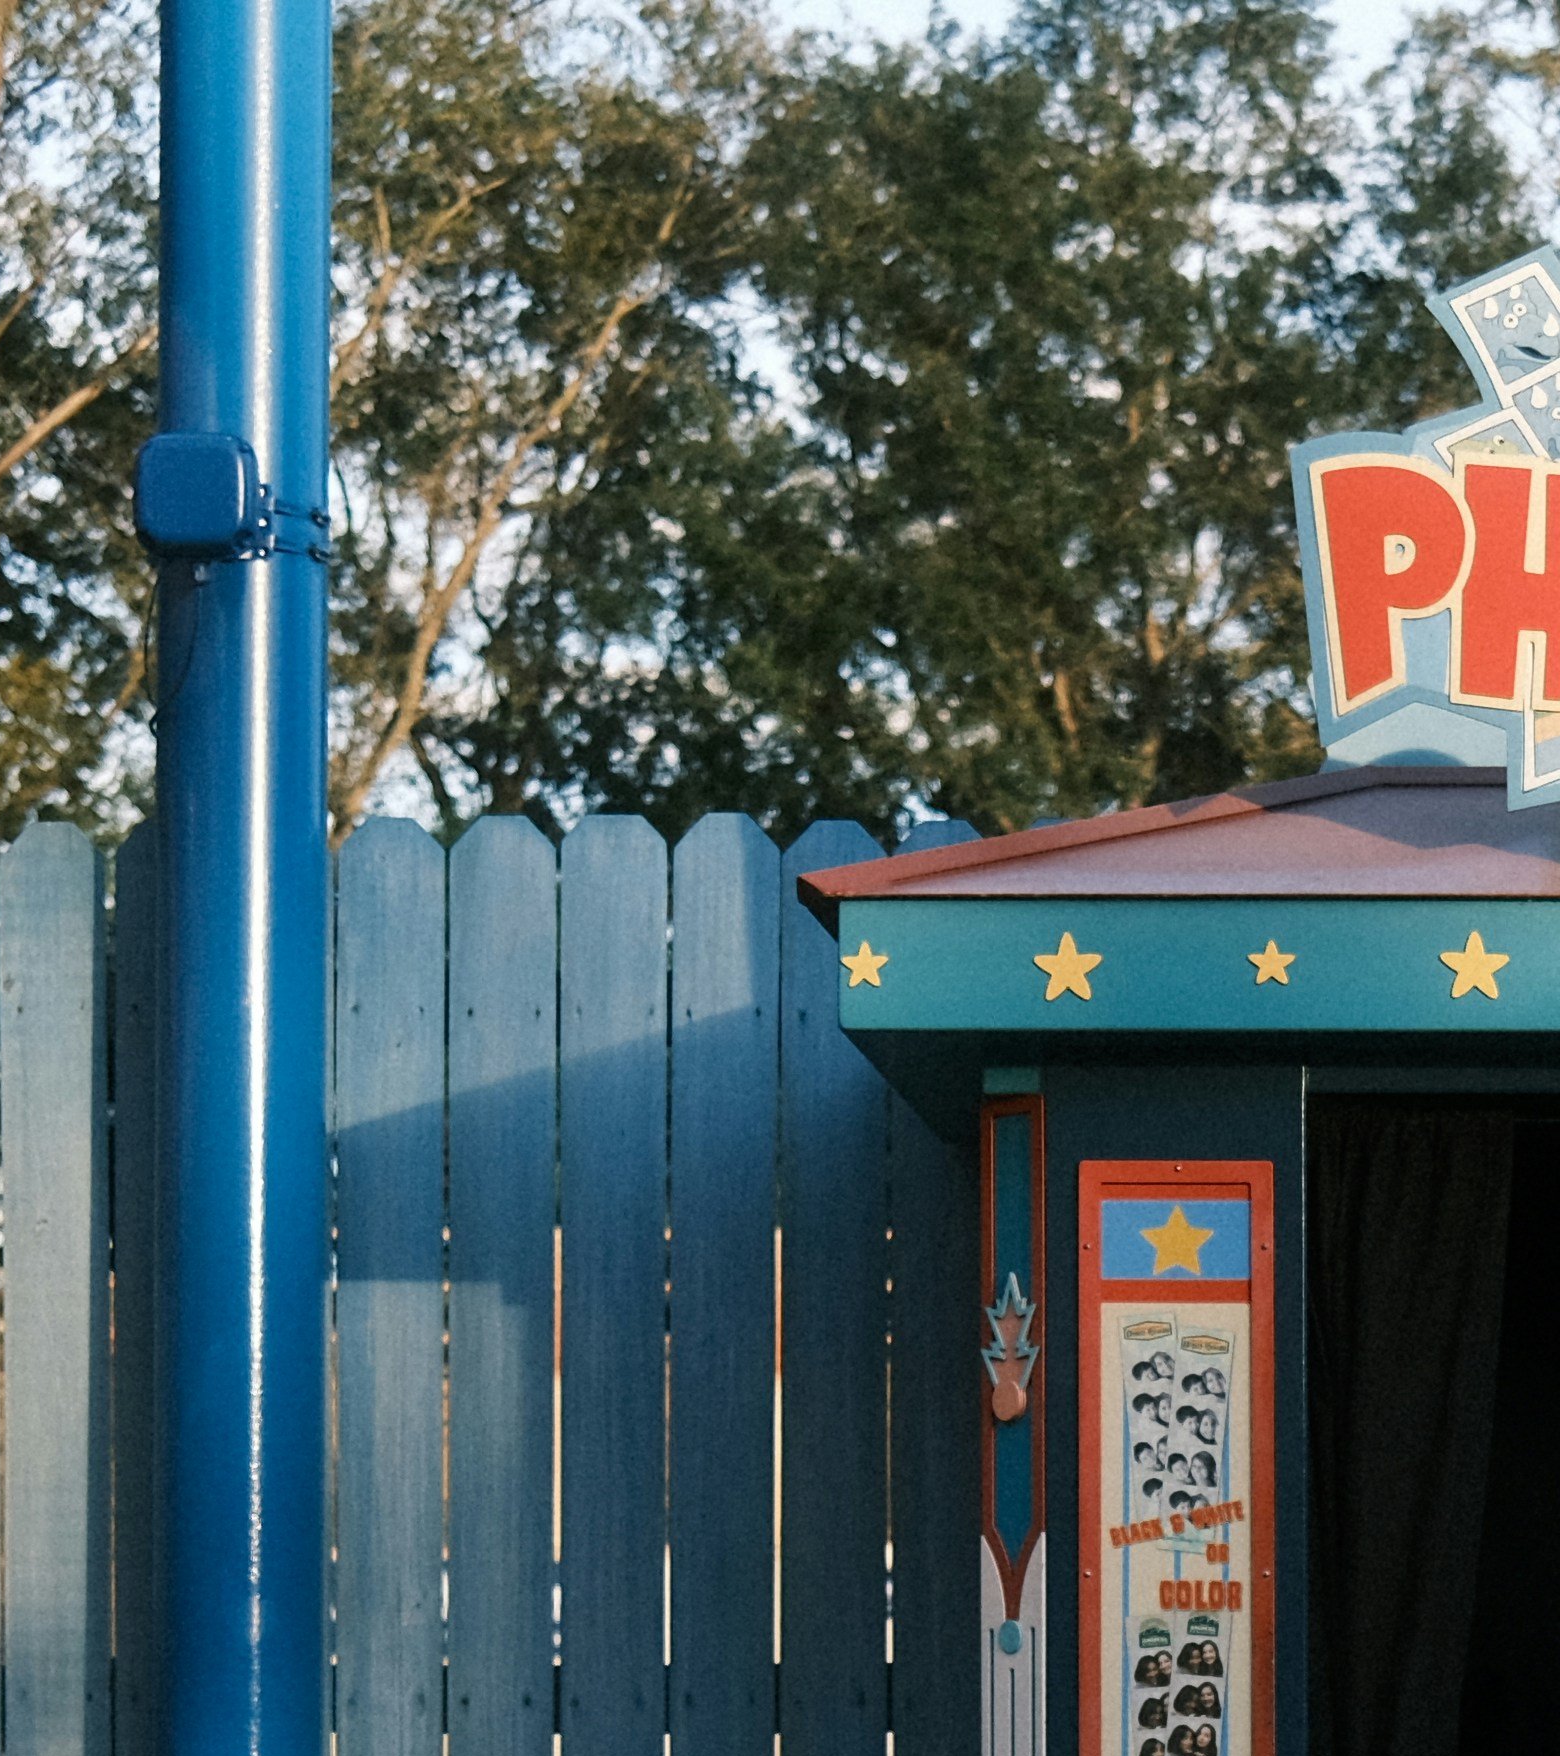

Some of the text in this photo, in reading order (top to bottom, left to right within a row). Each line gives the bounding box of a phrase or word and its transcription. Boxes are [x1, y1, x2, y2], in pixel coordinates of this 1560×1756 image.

[1110, 1518, 1164, 1548] BLACK
[1191, 1500, 1244, 1529] WHITE
[1206, 1543, 1230, 1564] OR
[1159, 1580, 1243, 1612] COLOR
